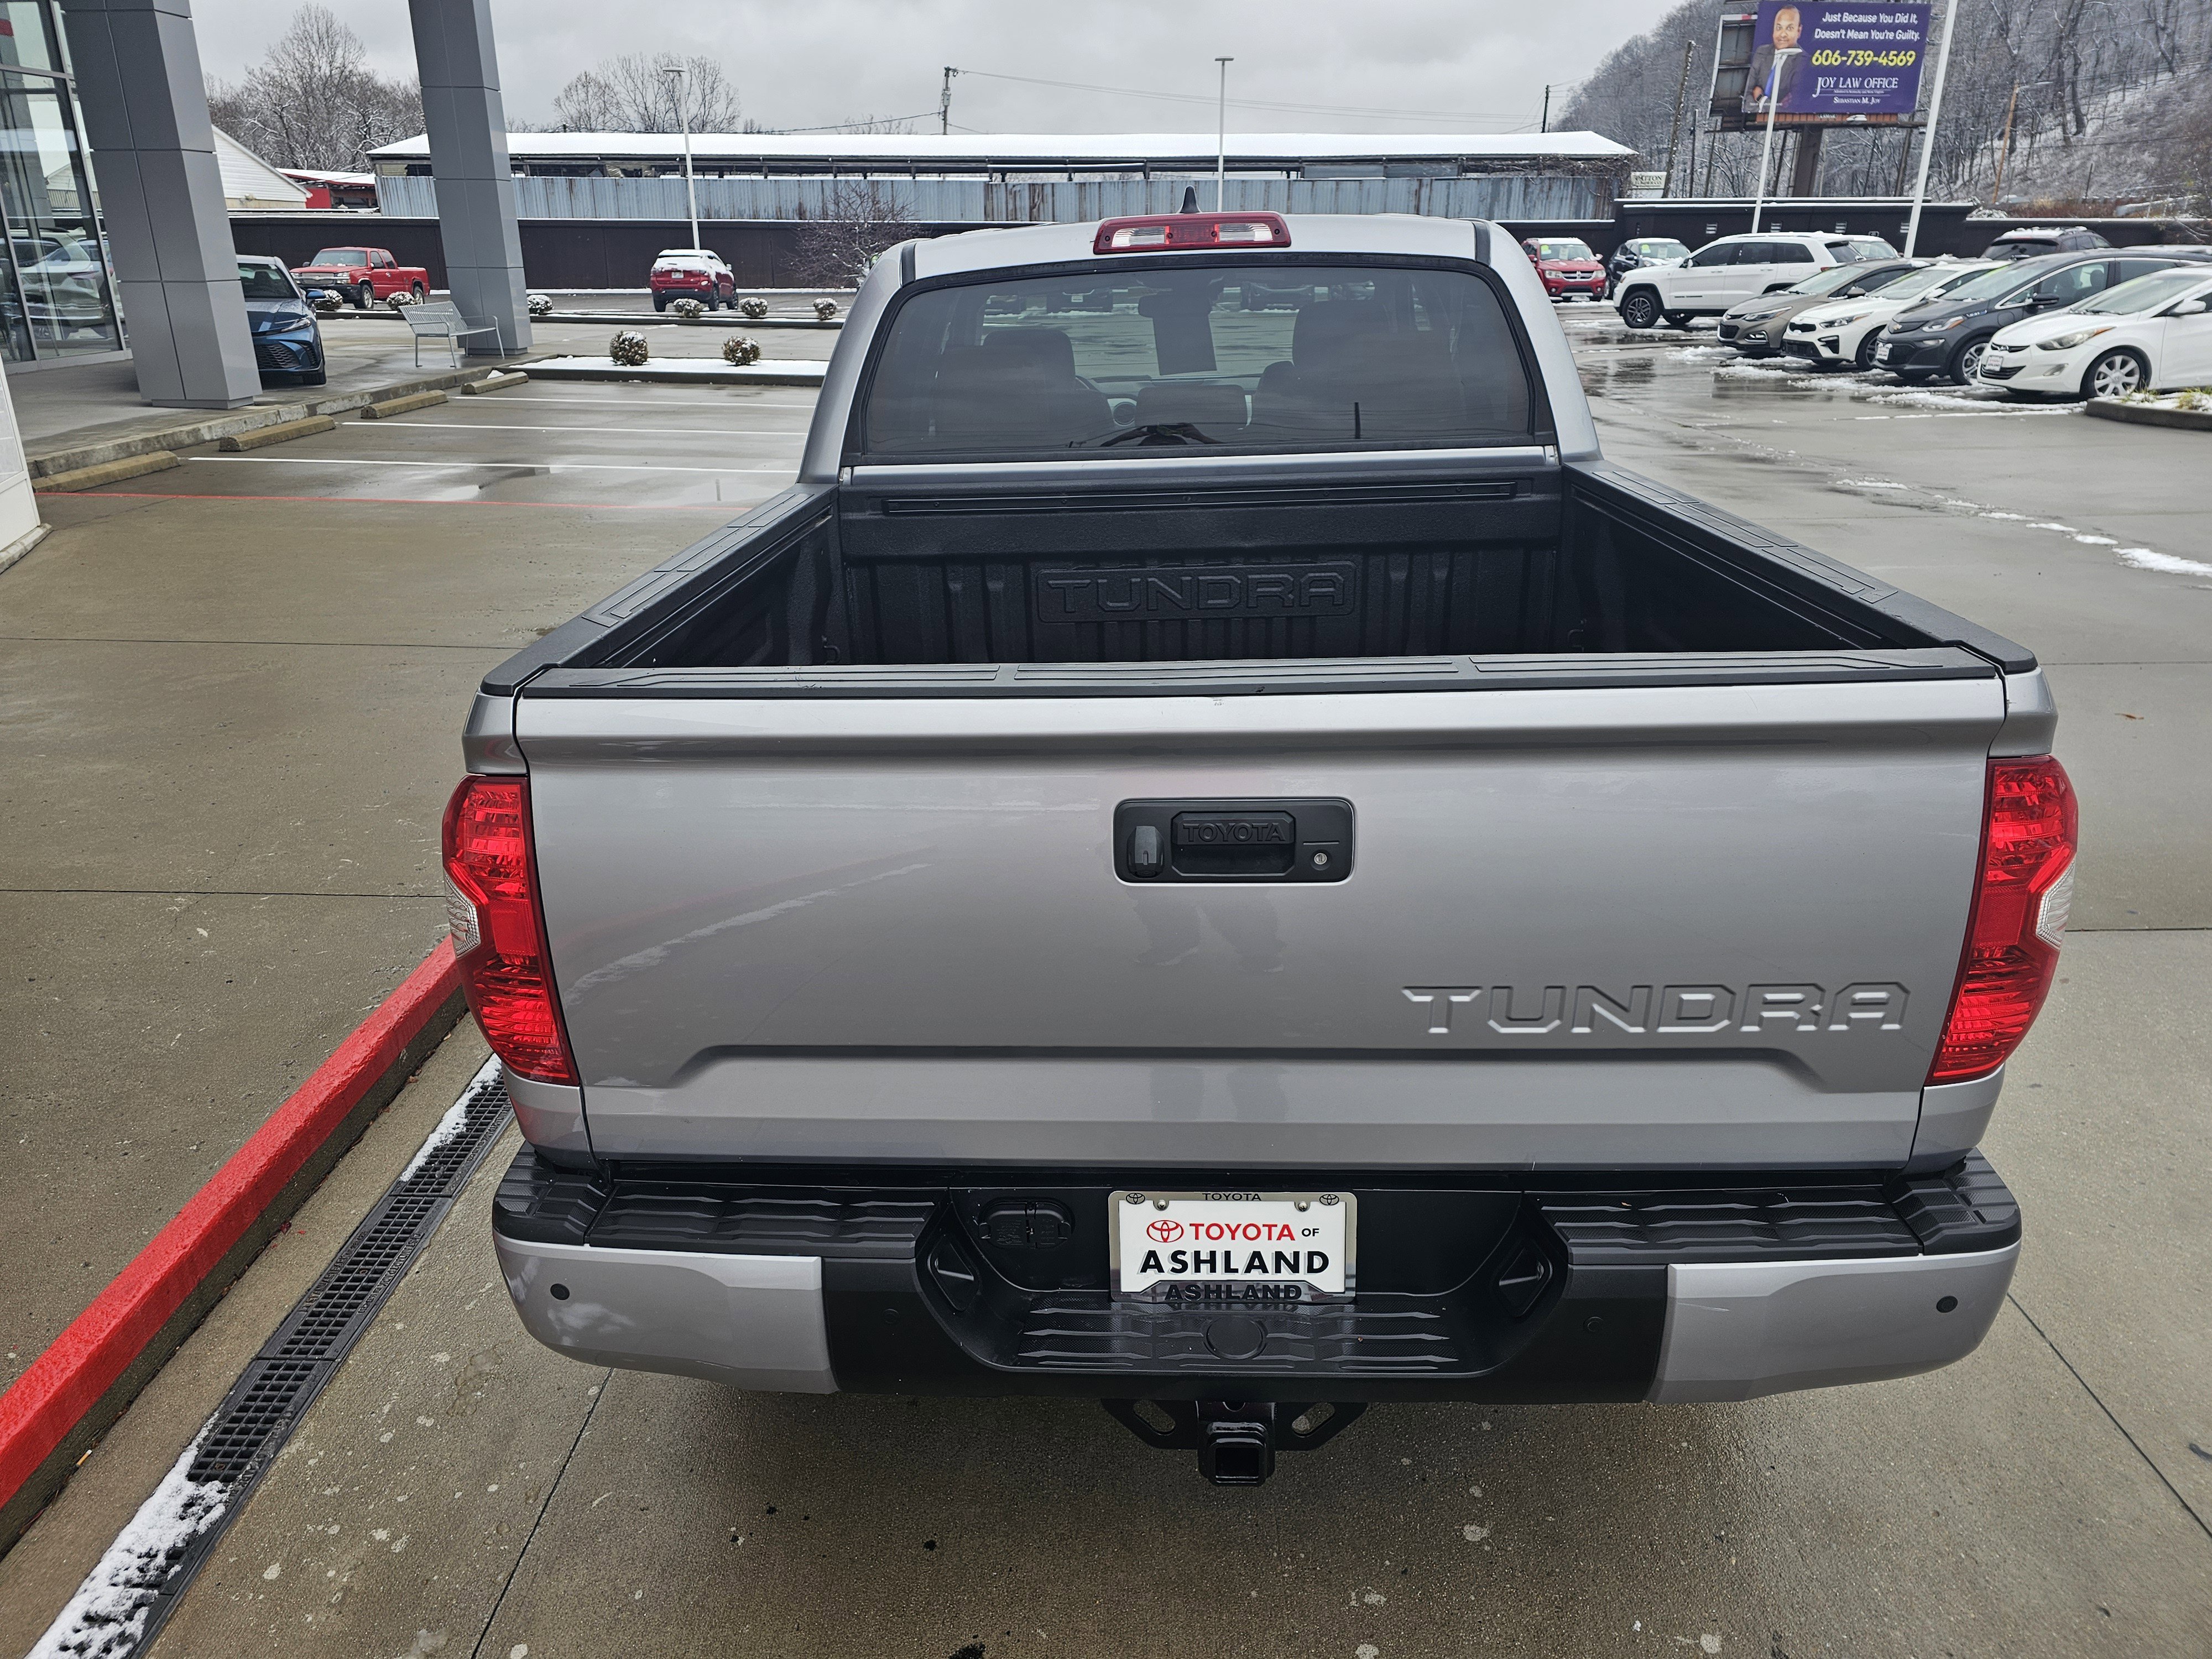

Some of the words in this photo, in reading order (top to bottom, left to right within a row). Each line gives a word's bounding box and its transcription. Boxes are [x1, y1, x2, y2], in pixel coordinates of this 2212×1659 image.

[1822, 12, 1841, 23] Just
[1843, 12, 1877, 23] Because
[1879, 13, 1893, 23] You
[1895, 13, 1909, 23] Did
[1910, 13, 1918, 25] It,
[1814, 28, 1846, 39] Doesn't
[1846, 29, 1869, 39] Mean
[1871, 29, 1894, 40] You're
[1896, 29, 1920, 41] Guilty.
[1812, 49, 1916, 66] 606-739-4569
[1812, 77, 1837, 98] JOY
[1839, 77, 1862, 88] LAW
[1864, 77, 1899, 89] OFFICE
[1047, 572, 1345, 614] TUNDRA
[1183, 822, 1286, 843] TOYOTA
[1402, 981, 1911, 1033] TUNDRA
[1202, 1192, 1262, 1202] TOYOTA
[1189, 1223, 1296, 1241] TOYOTA
[1301, 1228, 1320, 1238] OF
[1138, 1249, 1330, 1275] ASHLAND
[1164, 1284, 1302, 1302] ASHLAND
